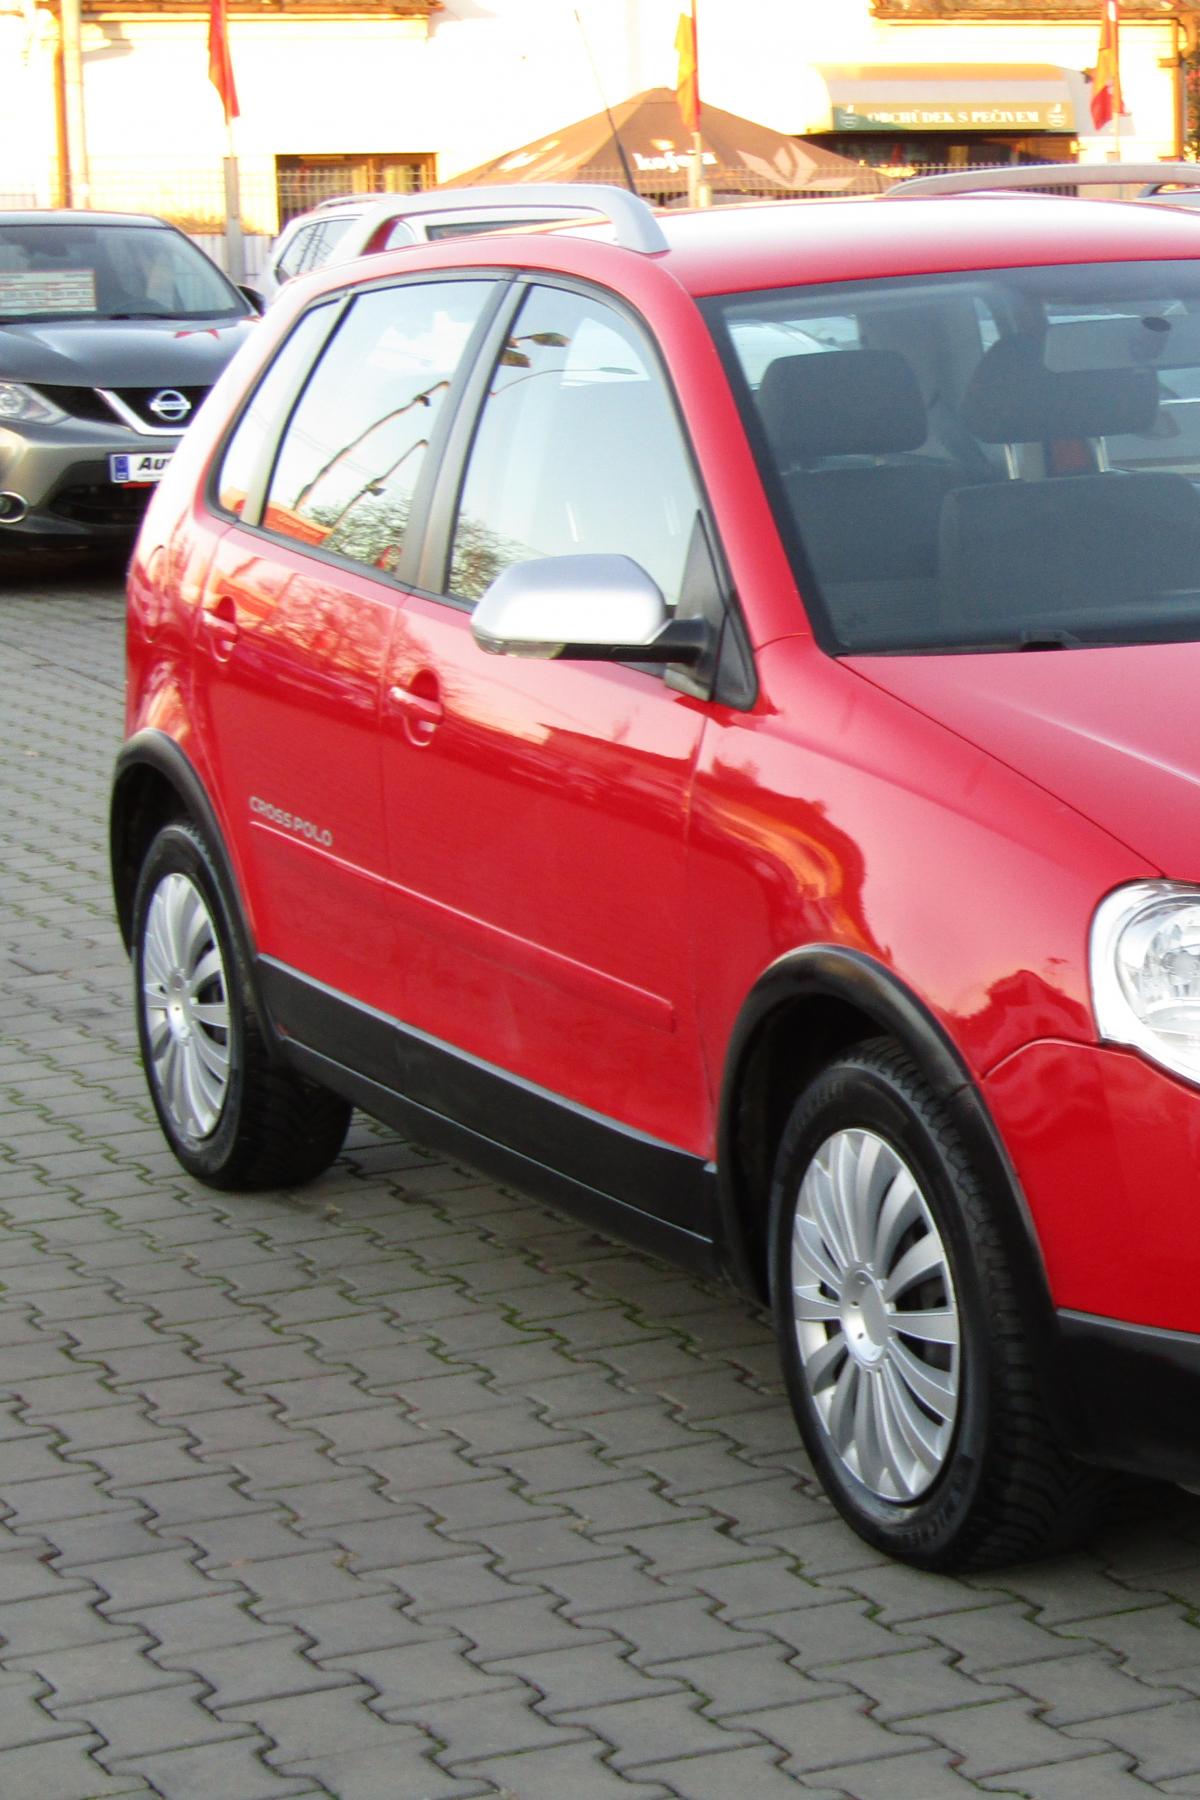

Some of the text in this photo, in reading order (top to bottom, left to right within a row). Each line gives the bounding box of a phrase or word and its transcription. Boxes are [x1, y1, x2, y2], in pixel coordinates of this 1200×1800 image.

[632, 150, 718, 174] kofoa
[249, 796, 334, 847] CROSS POLO
